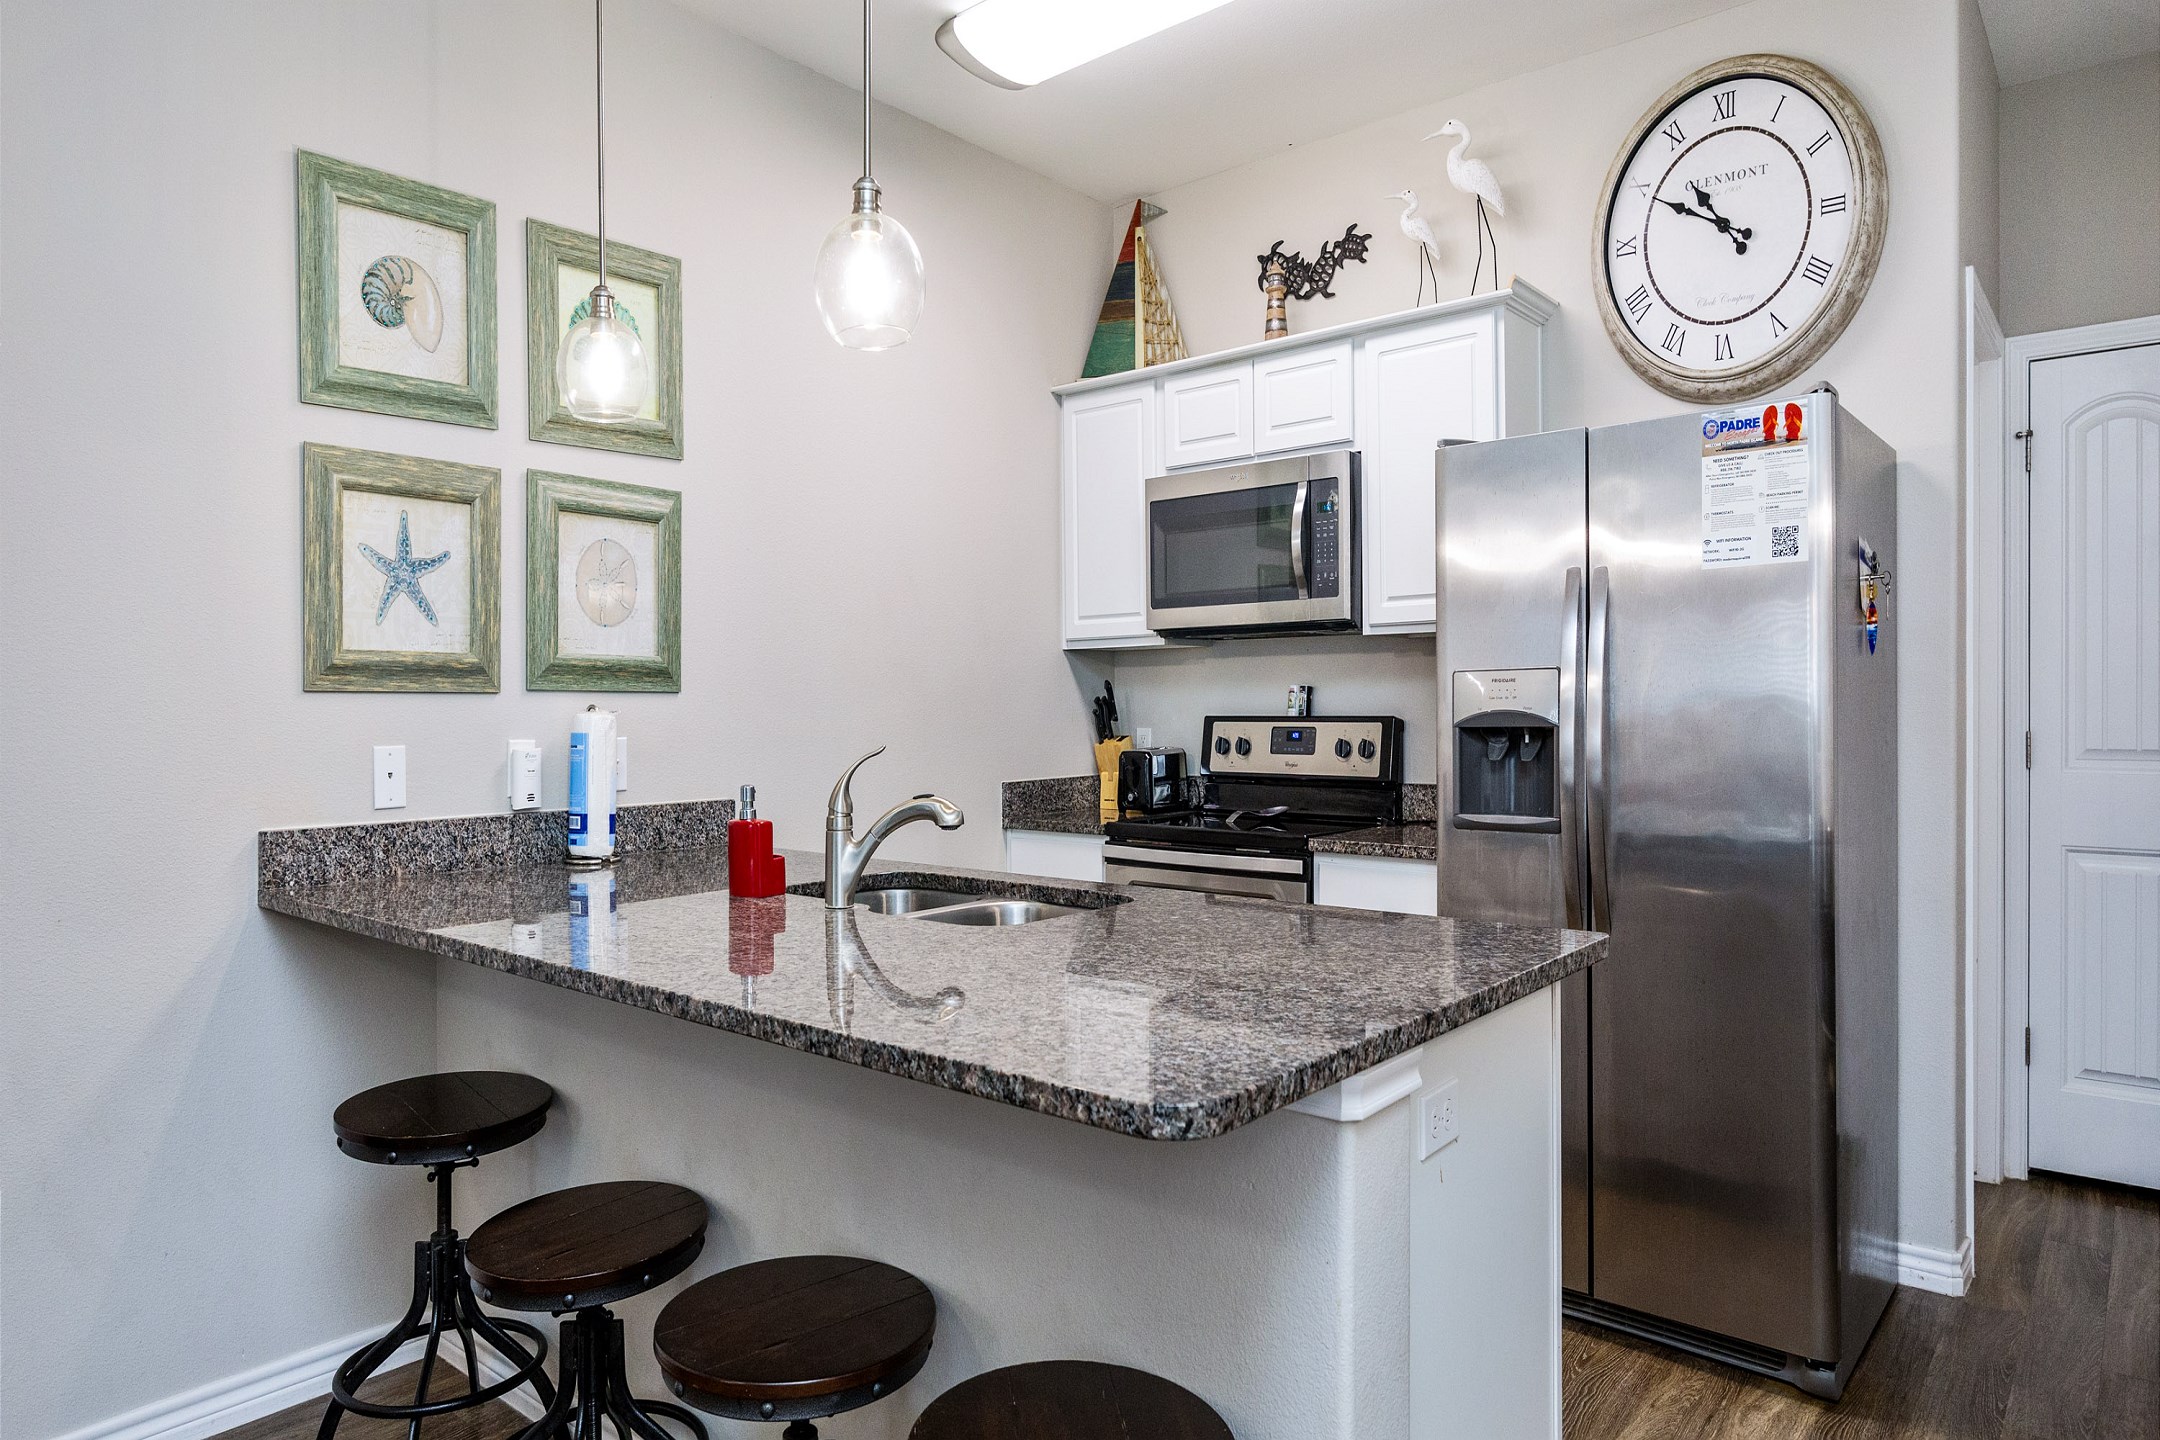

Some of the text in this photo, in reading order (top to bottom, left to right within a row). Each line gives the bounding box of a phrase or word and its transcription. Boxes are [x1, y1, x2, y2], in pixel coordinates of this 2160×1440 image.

[1712, 90, 1737, 122] XII
[1661, 119, 1687, 152] XI
[1806, 130, 1833, 158] II
[1821, 193, 1846, 217] III
[1616, 235, 1637, 259] IX
[1625, 284, 1653, 325] VIII
[1770, 312, 1789, 338] V
[1660, 322, 1687, 357] VII
[1715, 333, 1735, 361] VI
[1719, 417, 1761, 433] PADRE
[1723, 454, 1750, 462] SOMETHING?
